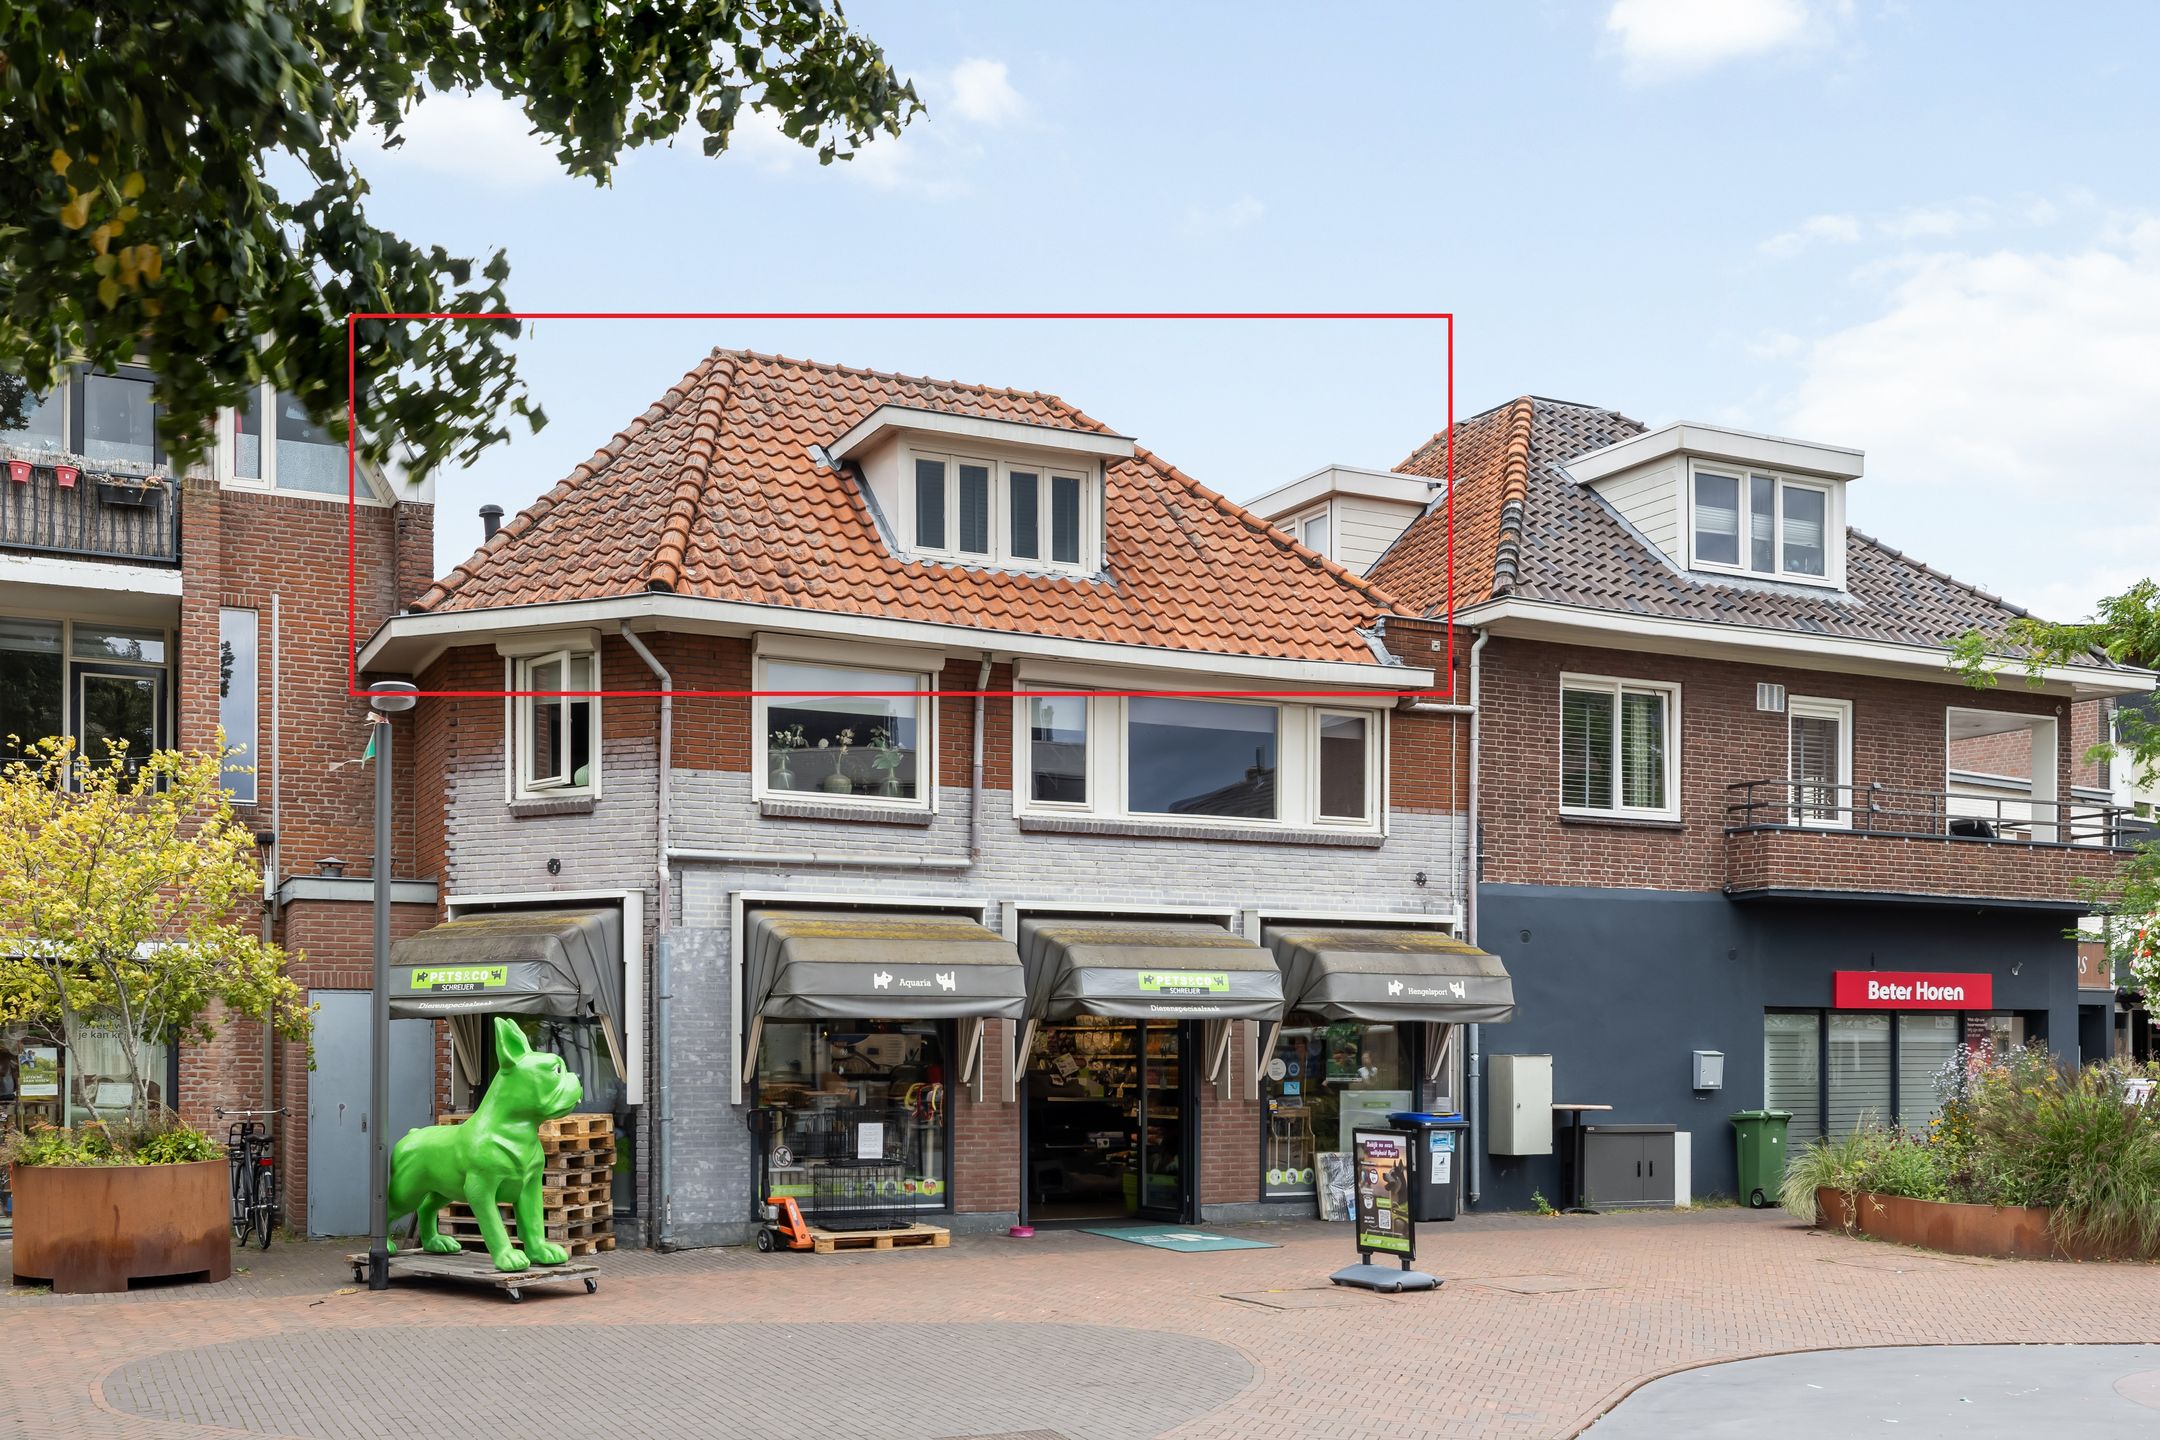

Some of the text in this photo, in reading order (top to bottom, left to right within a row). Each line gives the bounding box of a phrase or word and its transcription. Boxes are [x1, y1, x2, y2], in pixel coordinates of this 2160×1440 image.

[429, 970, 489, 983] PETS&CO
[1156, 975, 1212, 986] PETS&CO
[441, 983, 474, 991] SCHREIJER
[899, 978, 932, 989] Aquaria
[1408, 987, 1448, 997] Hengelsport
[1868, 980, 1964, 1001] Beter Horen
[78, 1030, 88, 1040] je
[91, 1030, 109, 1039] kan
